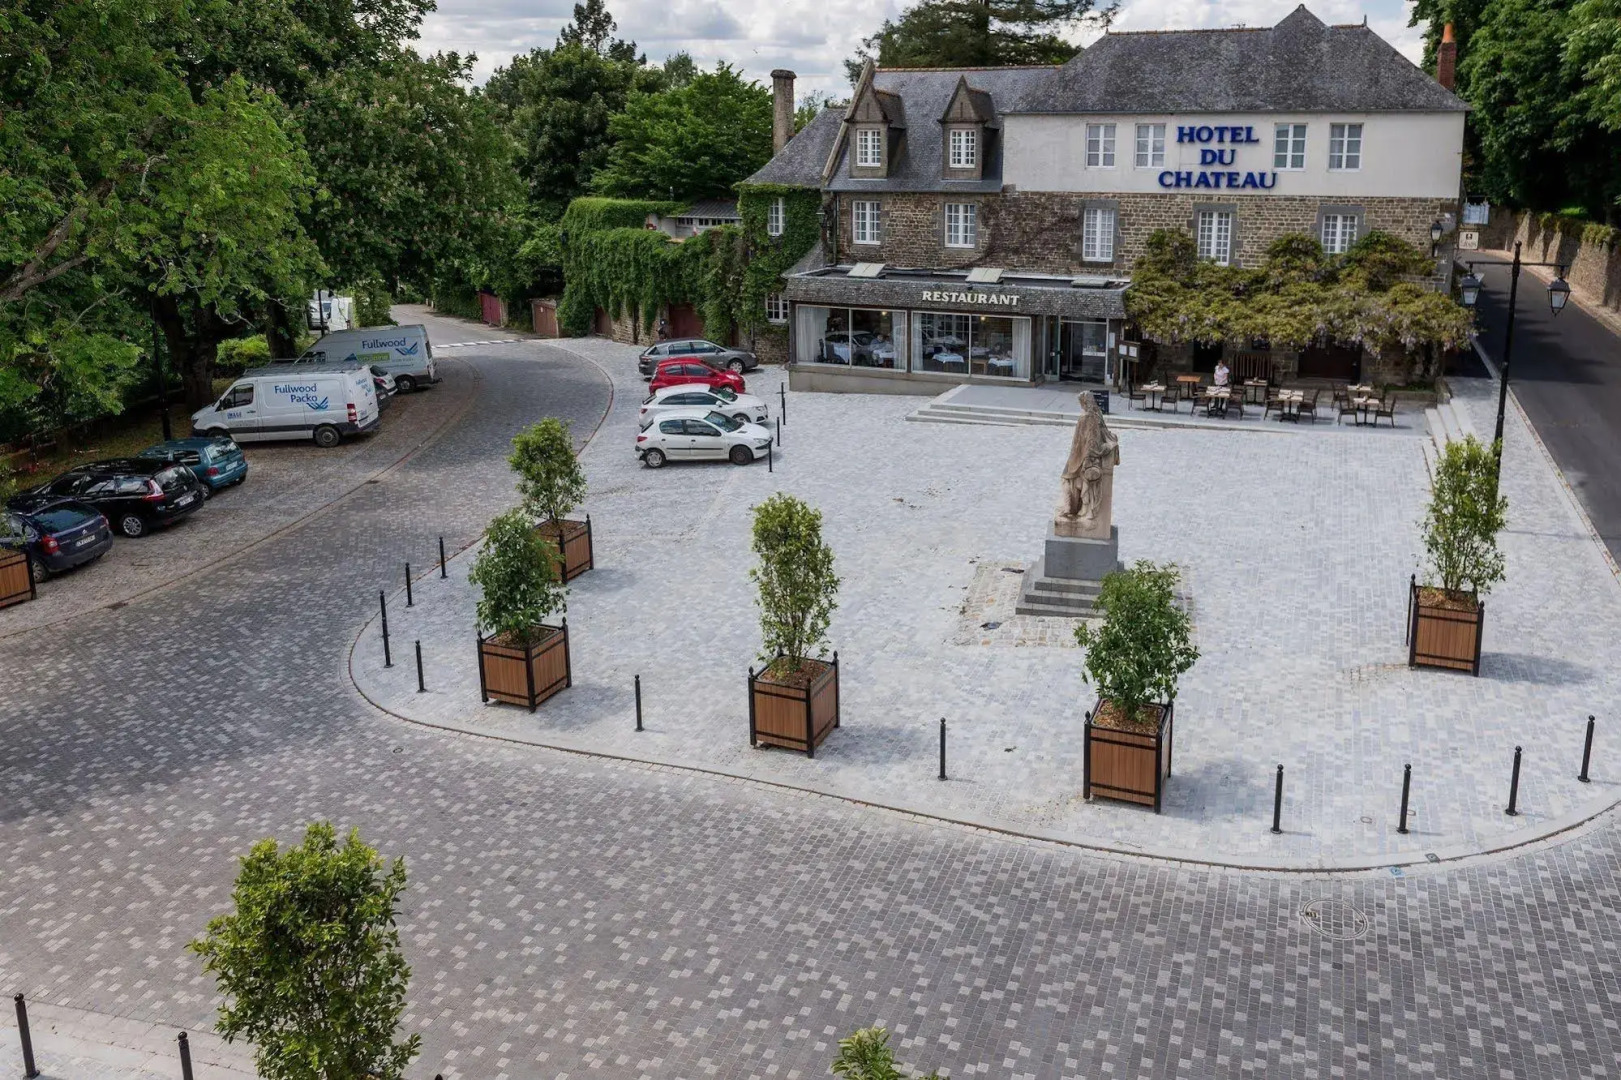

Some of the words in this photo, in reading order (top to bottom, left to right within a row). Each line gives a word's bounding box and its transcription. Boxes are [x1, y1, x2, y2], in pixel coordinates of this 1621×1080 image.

[1176, 126, 1259, 143] HOTEL
[1200, 149, 1236, 166] DU
[1158, 171, 1277, 188] CHATEAU
[922, 290, 1020, 305] RESTAURANT
[362, 337, 406, 349] Fullwood
[274, 383, 317, 394] Fullwood
[290, 393, 318, 403] Packo
